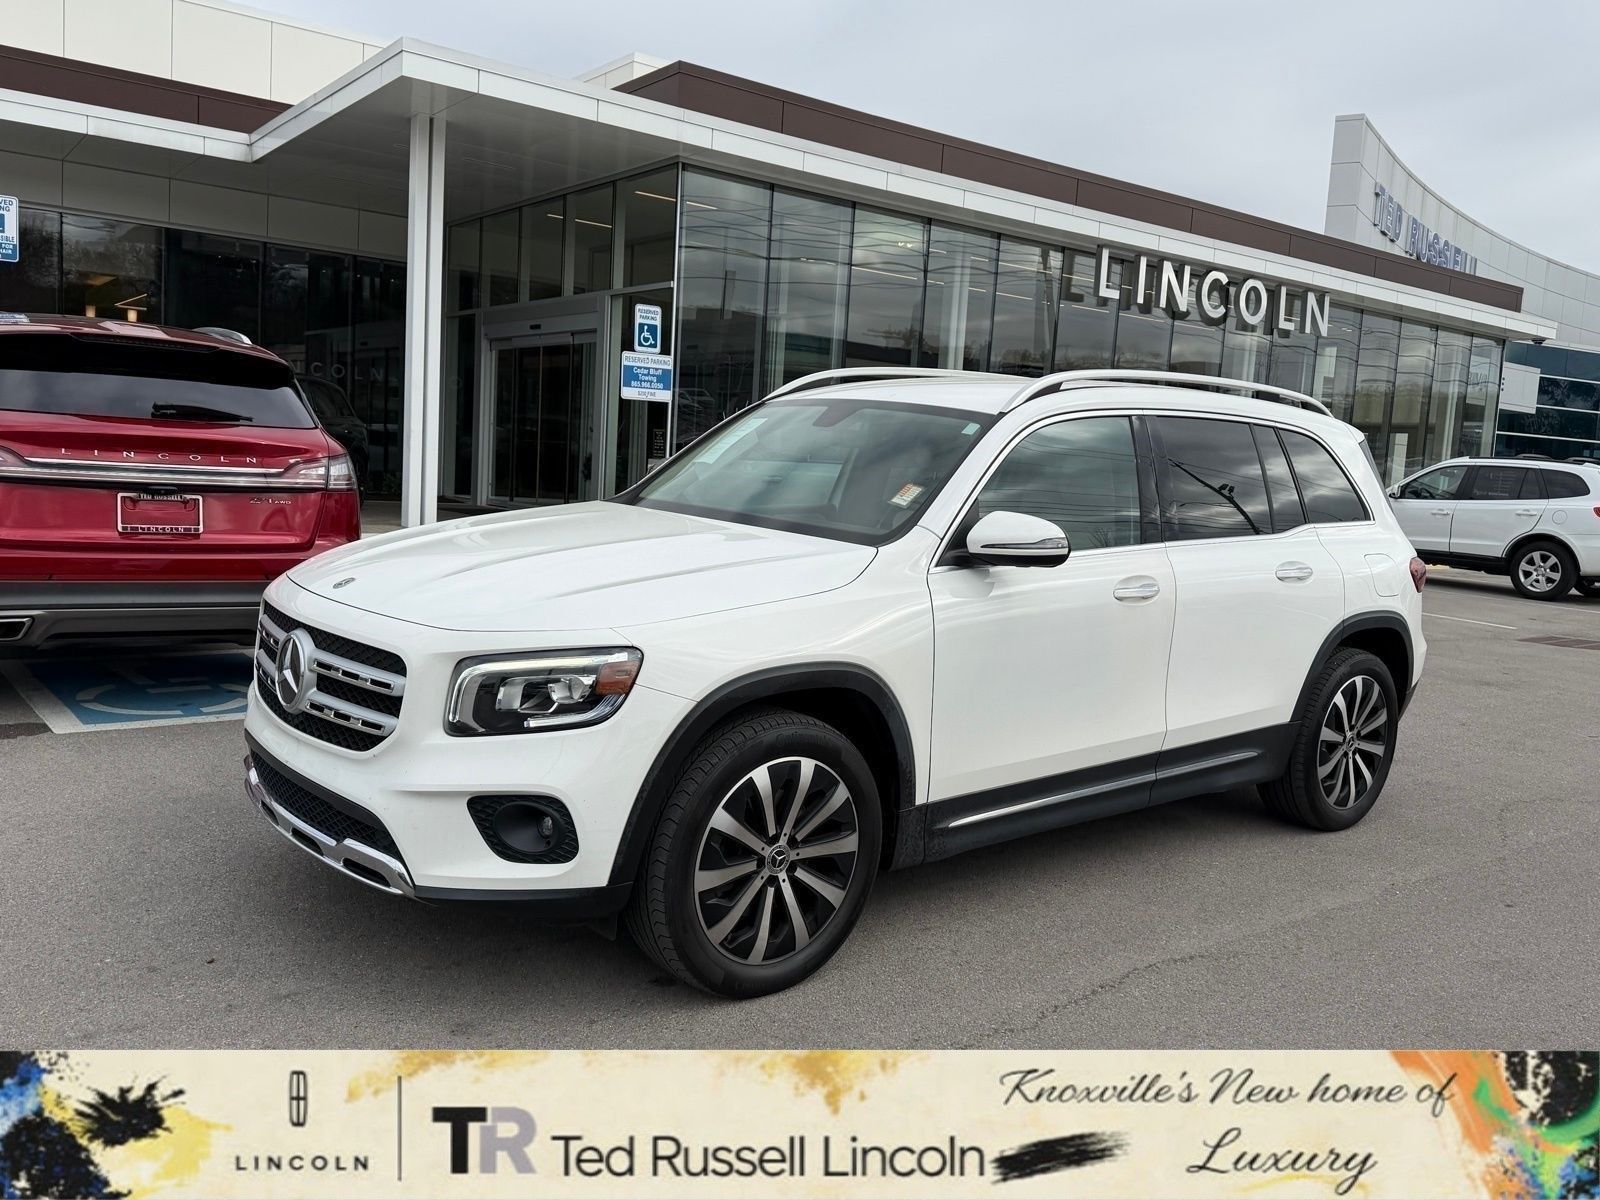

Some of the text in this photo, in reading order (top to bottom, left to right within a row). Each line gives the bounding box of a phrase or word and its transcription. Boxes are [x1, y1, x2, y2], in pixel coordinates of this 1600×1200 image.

[1374, 182, 1402, 242] TED
[1094, 245, 1330, 338] LINCOLN
[638, 308, 659, 316] RESERVED
[624, 355, 670, 366] RESERVED PARKING
[638, 374, 657, 382] Towing
[61, 448, 257, 463] LINCOLN
[139, 525, 184, 533] LINCOLN
